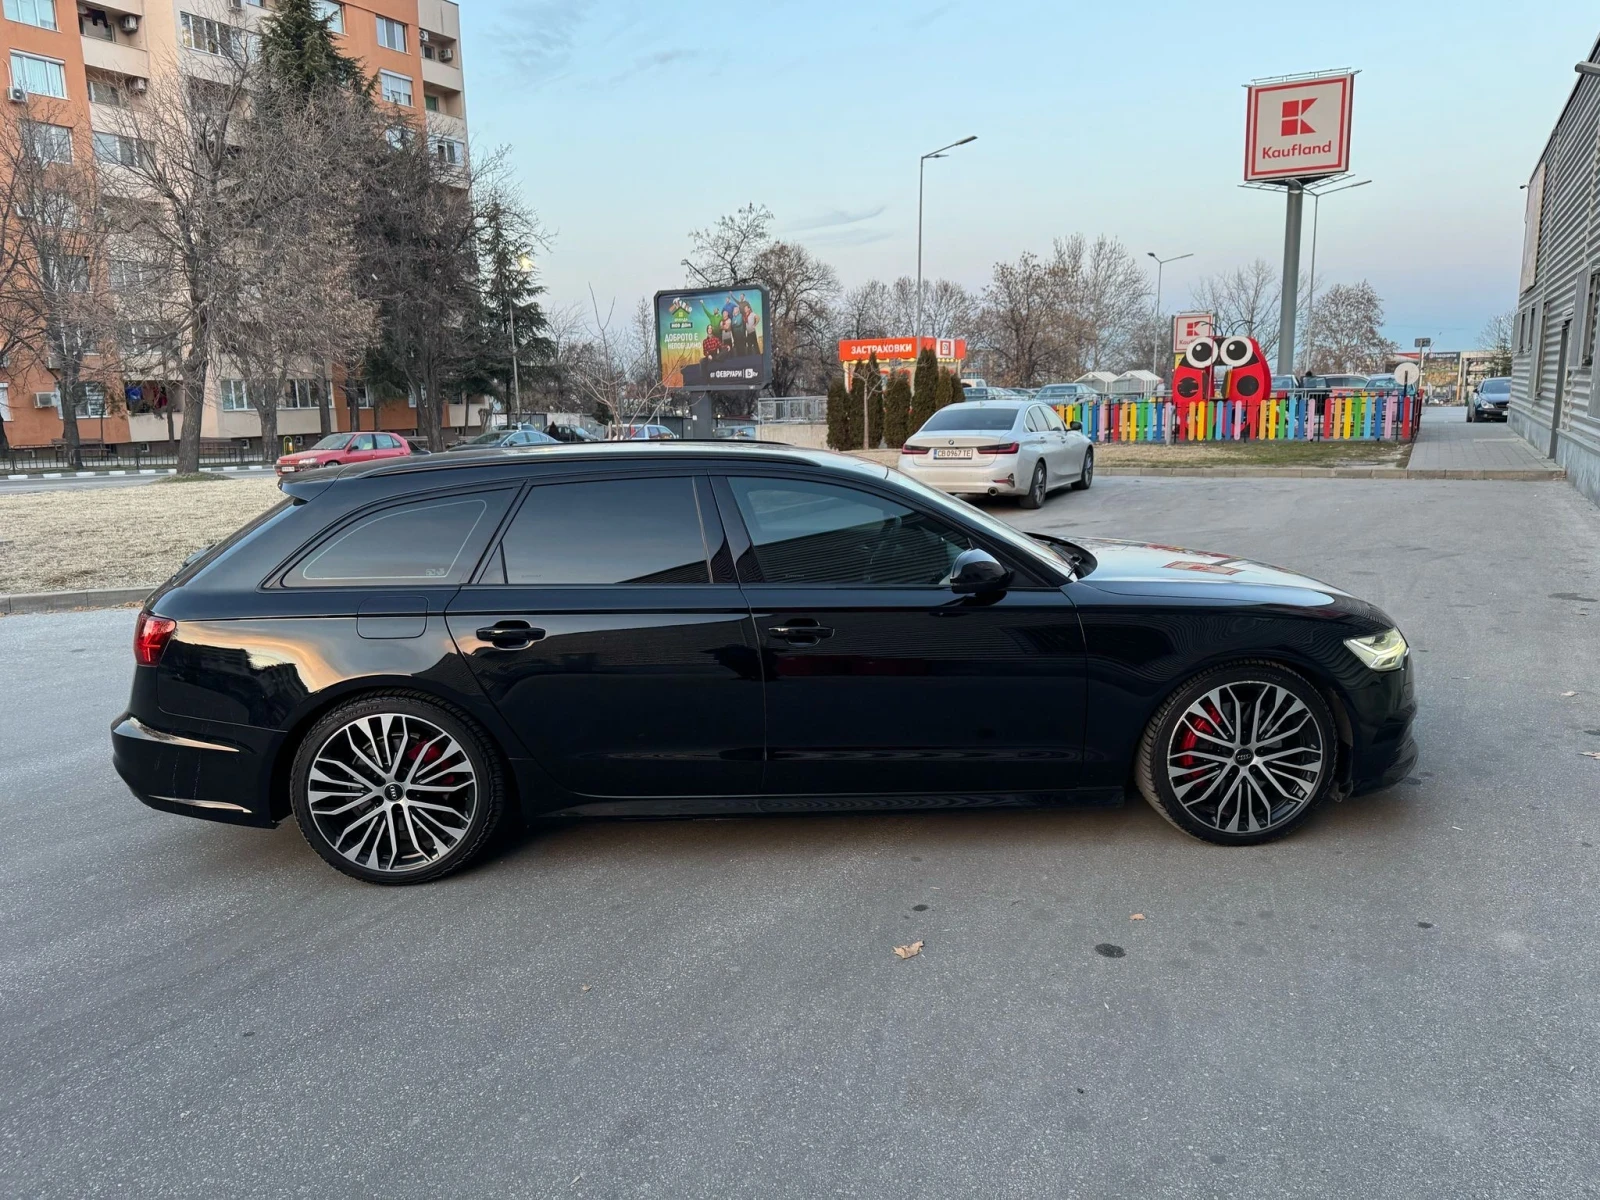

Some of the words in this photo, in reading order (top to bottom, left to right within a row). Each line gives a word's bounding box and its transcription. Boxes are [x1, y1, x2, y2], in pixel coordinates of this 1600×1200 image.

[1262, 140, 1332, 159] Kaufland
[664, 333, 692, 343] ДОБРОТО
[851, 343, 912, 355] ЗАСТРАХОВКИ
[715, 370, 742, 378] ФЕВРУАРИ
